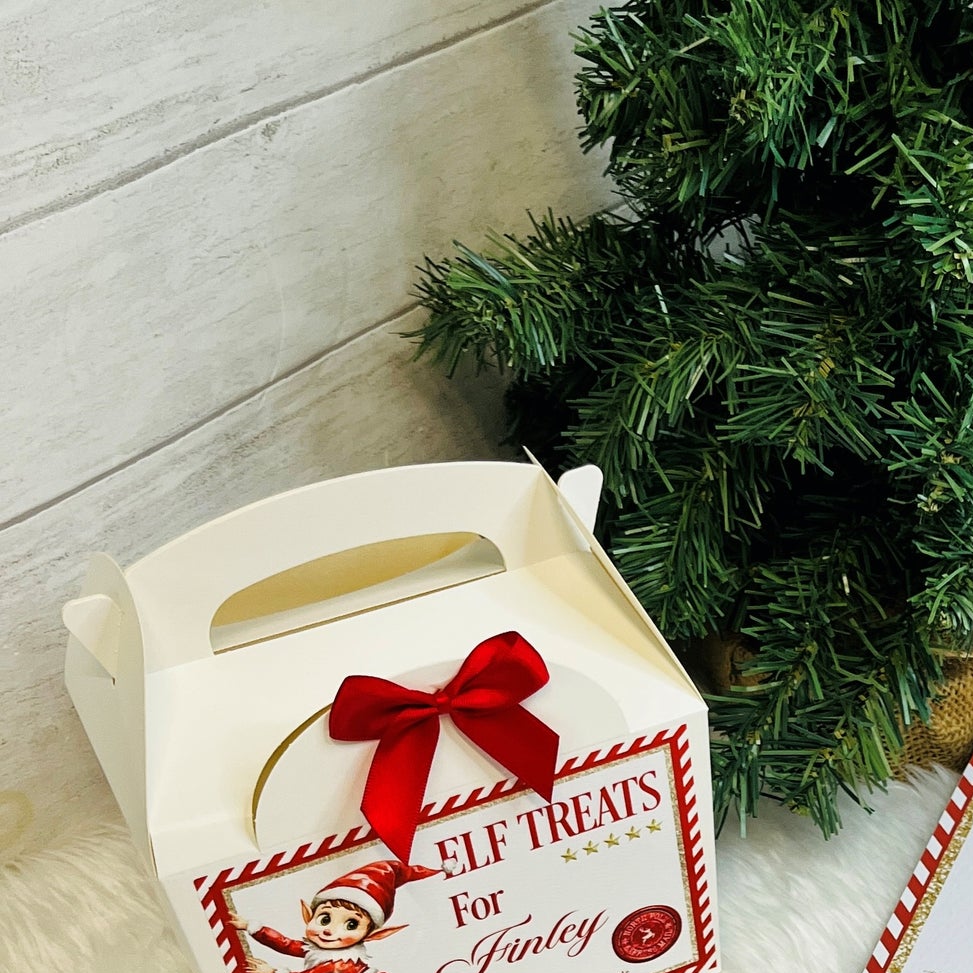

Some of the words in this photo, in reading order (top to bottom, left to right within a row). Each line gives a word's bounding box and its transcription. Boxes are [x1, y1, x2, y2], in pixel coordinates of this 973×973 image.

[434, 820, 509, 881] ELF
[516, 770, 662, 852] TREATS
[448, 889, 504, 928] For
